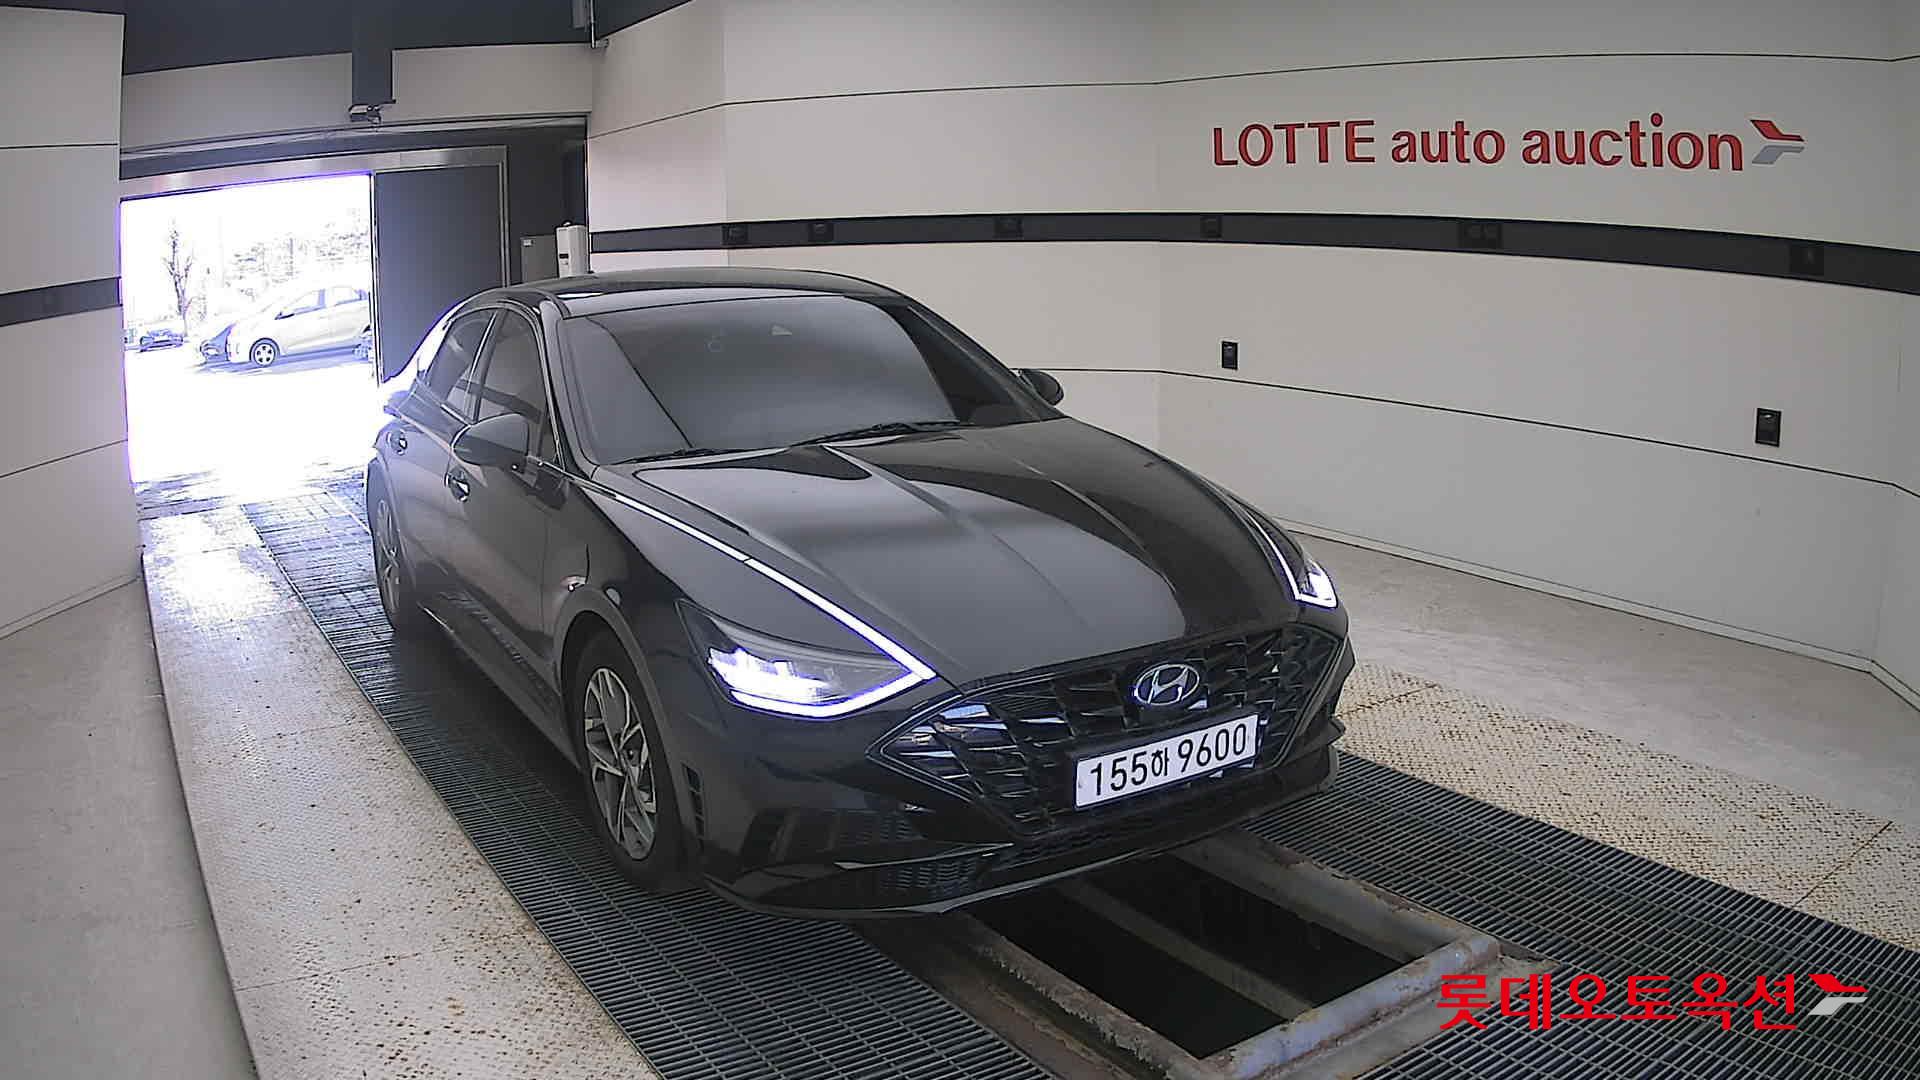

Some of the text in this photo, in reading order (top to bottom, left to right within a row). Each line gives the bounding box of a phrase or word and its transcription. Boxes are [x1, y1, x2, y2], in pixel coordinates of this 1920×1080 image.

[1213, 112, 1743, 170] LOTTE auto auction
[1091, 723, 1247, 796] 155하 9600
